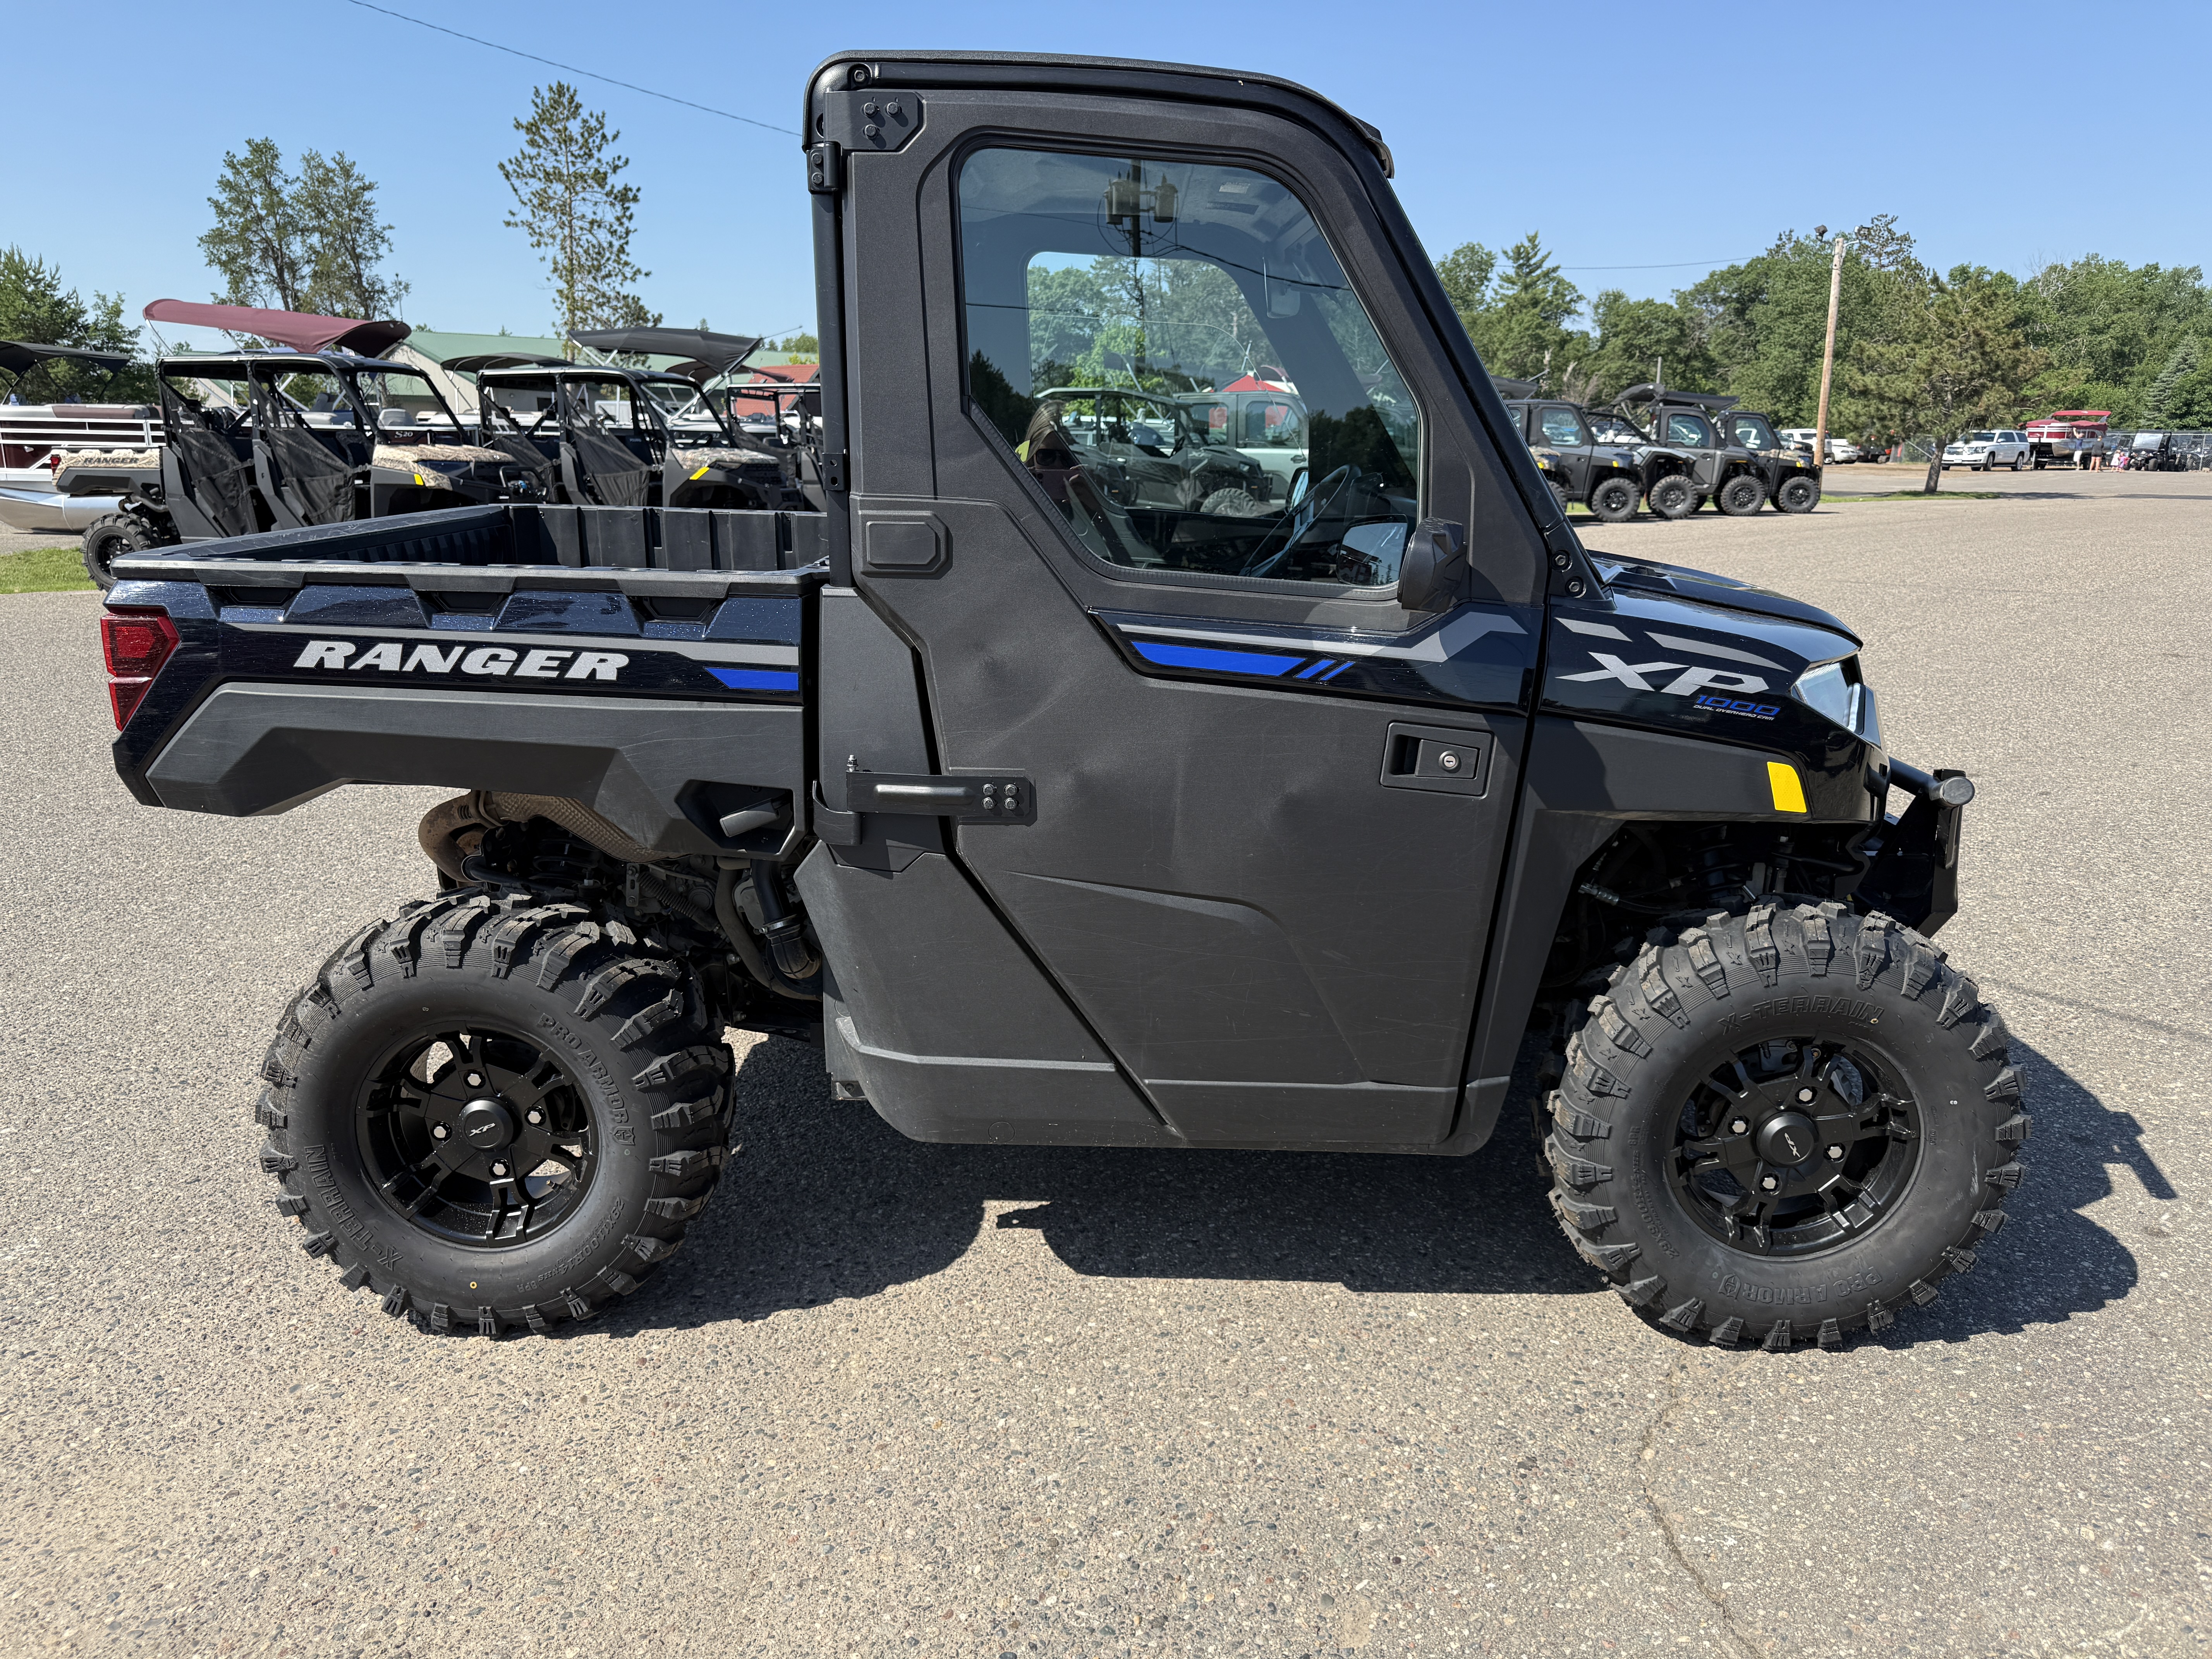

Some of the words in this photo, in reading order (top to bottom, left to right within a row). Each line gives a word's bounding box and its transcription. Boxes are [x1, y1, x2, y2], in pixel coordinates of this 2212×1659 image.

[293, 640, 629, 681] RANGER
[1555, 651, 1769, 696] XP
[1695, 694, 1781, 716] 1000
[1716, 708, 1757, 718] OVERHEAD
[1717, 995, 1885, 1036] X-TERRAIN
[538, 1013, 582, 1050] PRO
[577, 1049, 629, 1123] ARMOR
[469, 1123, 496, 1137] XP
[1784, 1132, 1801, 1158] XP
[304, 1144, 404, 1272] X-TERRAIN
[1832, 1266, 1882, 1297] PRO
